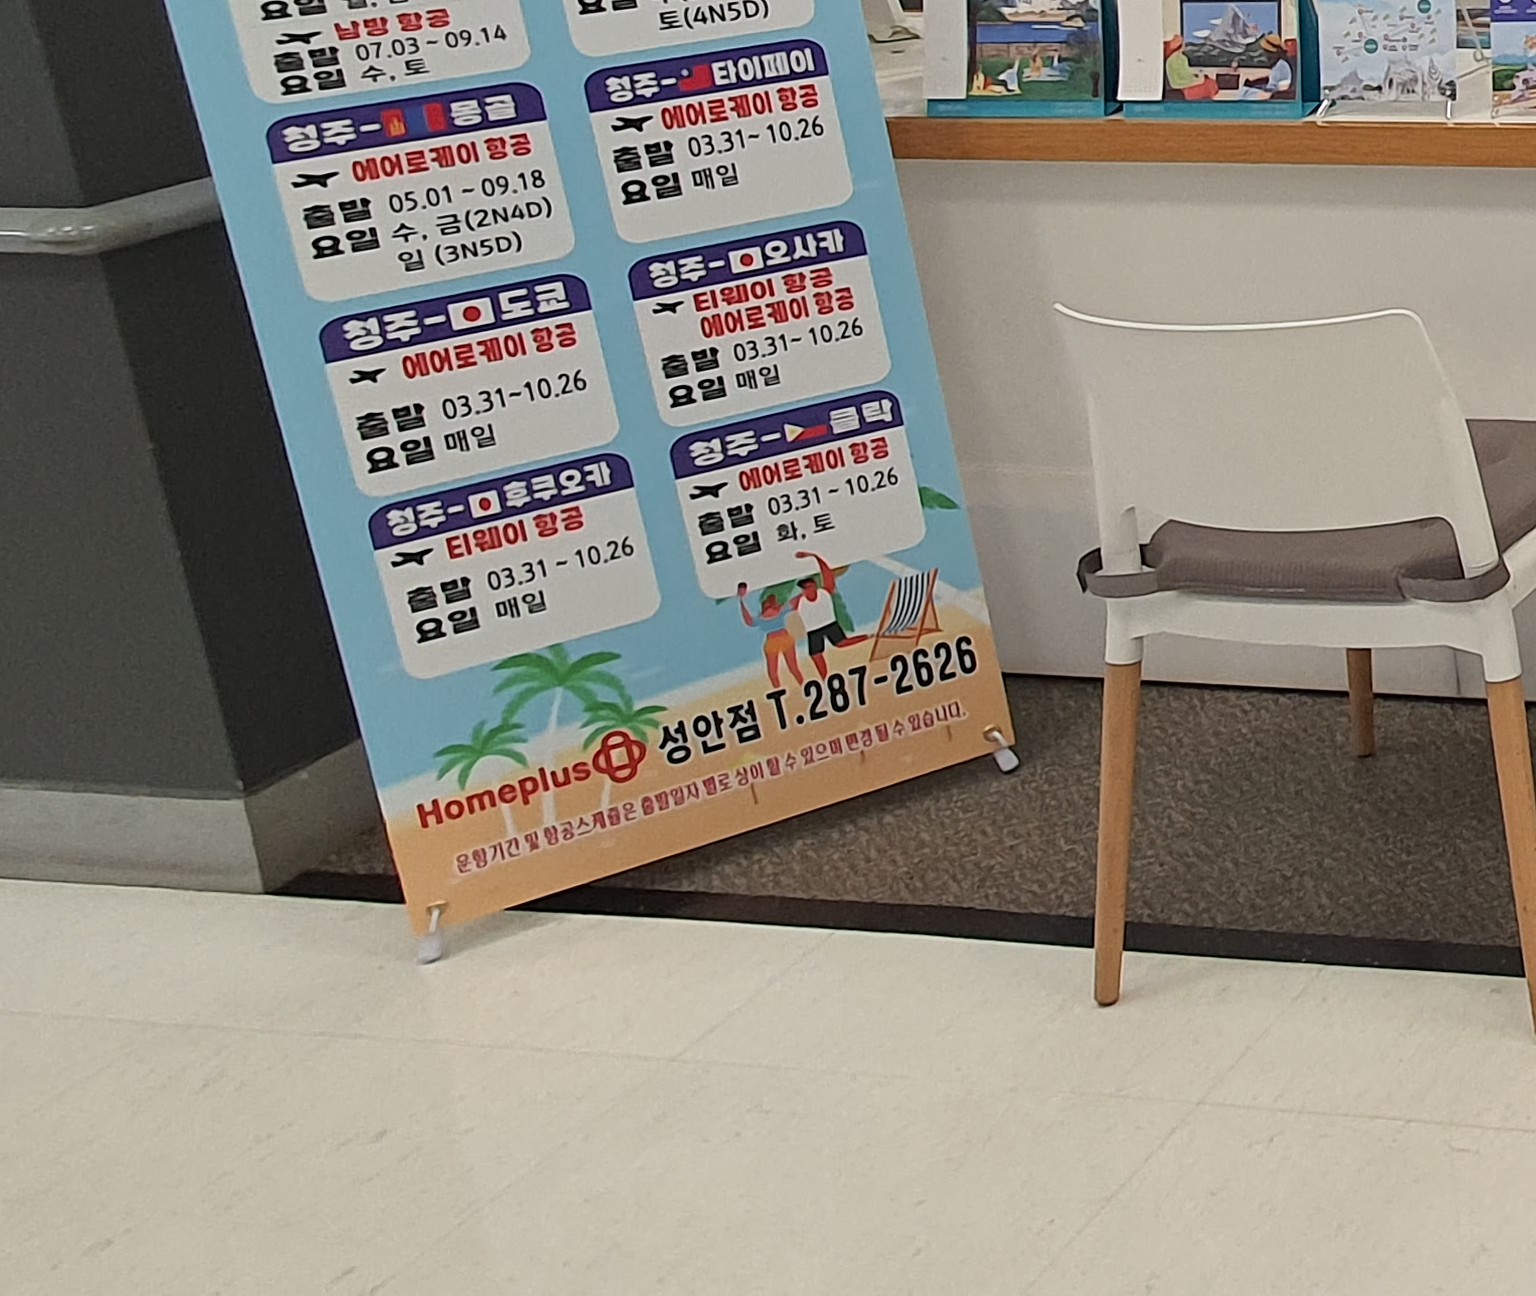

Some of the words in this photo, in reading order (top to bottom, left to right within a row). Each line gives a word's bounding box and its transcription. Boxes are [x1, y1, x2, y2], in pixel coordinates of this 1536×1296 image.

[711, 47, 816, 86] 타이페이
[450, 93, 518, 126] 몽골
[761, 227, 846, 265] 오사카
[498, 281, 572, 320] 도쿄
[827, 399, 895, 433] 클락
[505, 460, 612, 508] 후쿠오카
[416, 758, 591, 830] Homeplus
[658, 699, 762, 765] 성안점
[767, 635, 979, 732] T.287-2626
[456, 837, 520, 874] 운항기간
[525, 830, 540, 852] 및
[544, 801, 638, 847] 항공스케줄은
[641, 782, 700, 817] 출발일자
[702, 772, 733, 796] 별로
[734, 761, 764, 786] 상이
[784, 752, 797, 770] 수
[800, 737, 842, 766] 있으며
[845, 729, 873, 751] 변경
[892, 719, 905, 737] 수
[907, 701, 967, 732] 있습니다.
